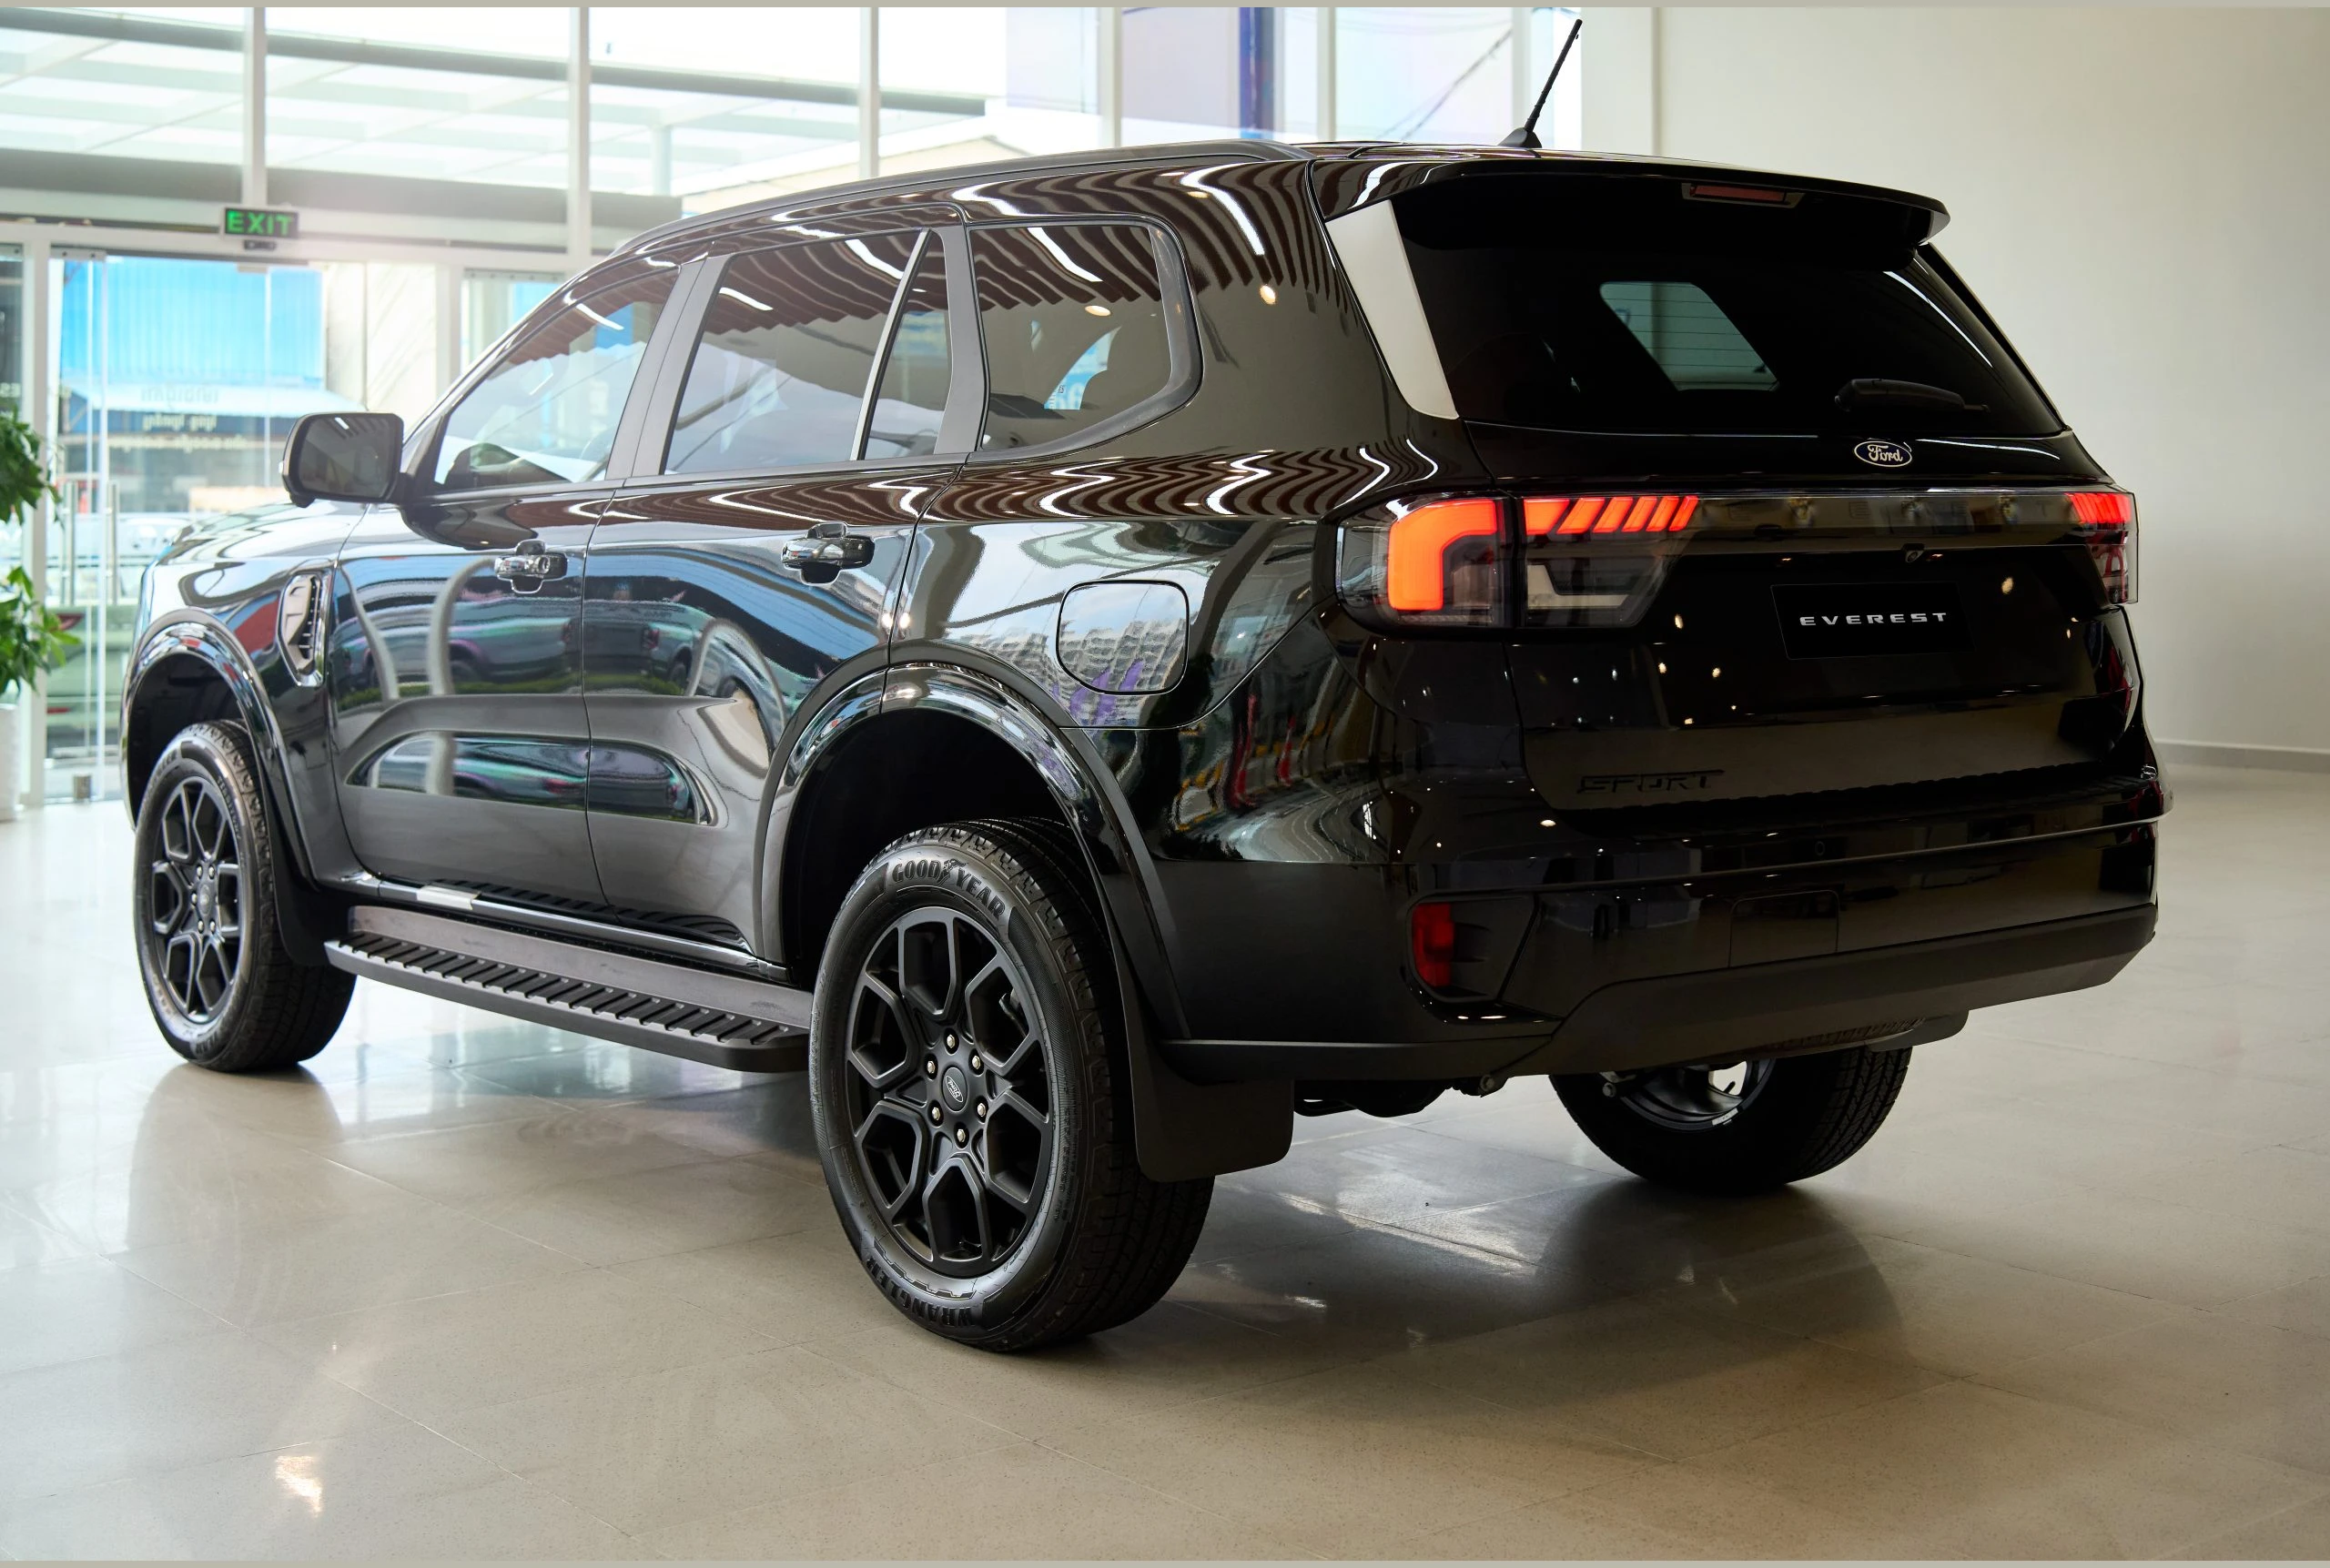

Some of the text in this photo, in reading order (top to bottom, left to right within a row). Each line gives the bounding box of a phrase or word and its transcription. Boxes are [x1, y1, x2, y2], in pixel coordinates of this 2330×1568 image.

[228, 210, 293, 236] EXIT
[1867, 444, 1903, 462] Ford
[1799, 612, 1947, 626] EVEREST
[1576, 769, 1726, 794] SPORT
